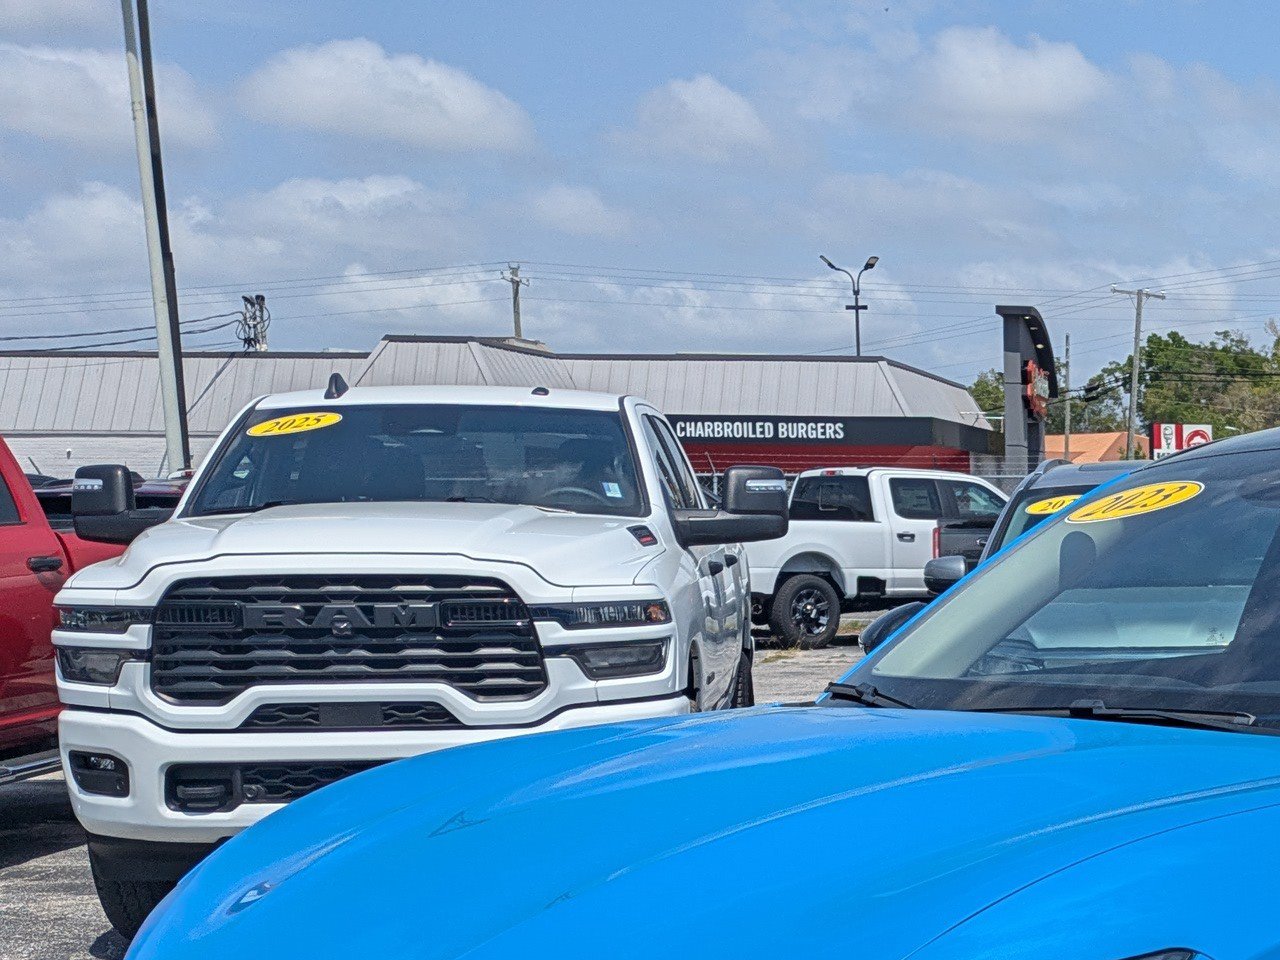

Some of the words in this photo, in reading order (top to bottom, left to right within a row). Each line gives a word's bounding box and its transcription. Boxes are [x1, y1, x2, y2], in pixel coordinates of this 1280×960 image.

[261, 415, 328, 434] 2025
[676, 421, 774, 438] CHARBROILED
[778, 422, 844, 439] BURGERS
[1079, 485, 1187, 518] 2023
[244, 603, 435, 628] RAM
